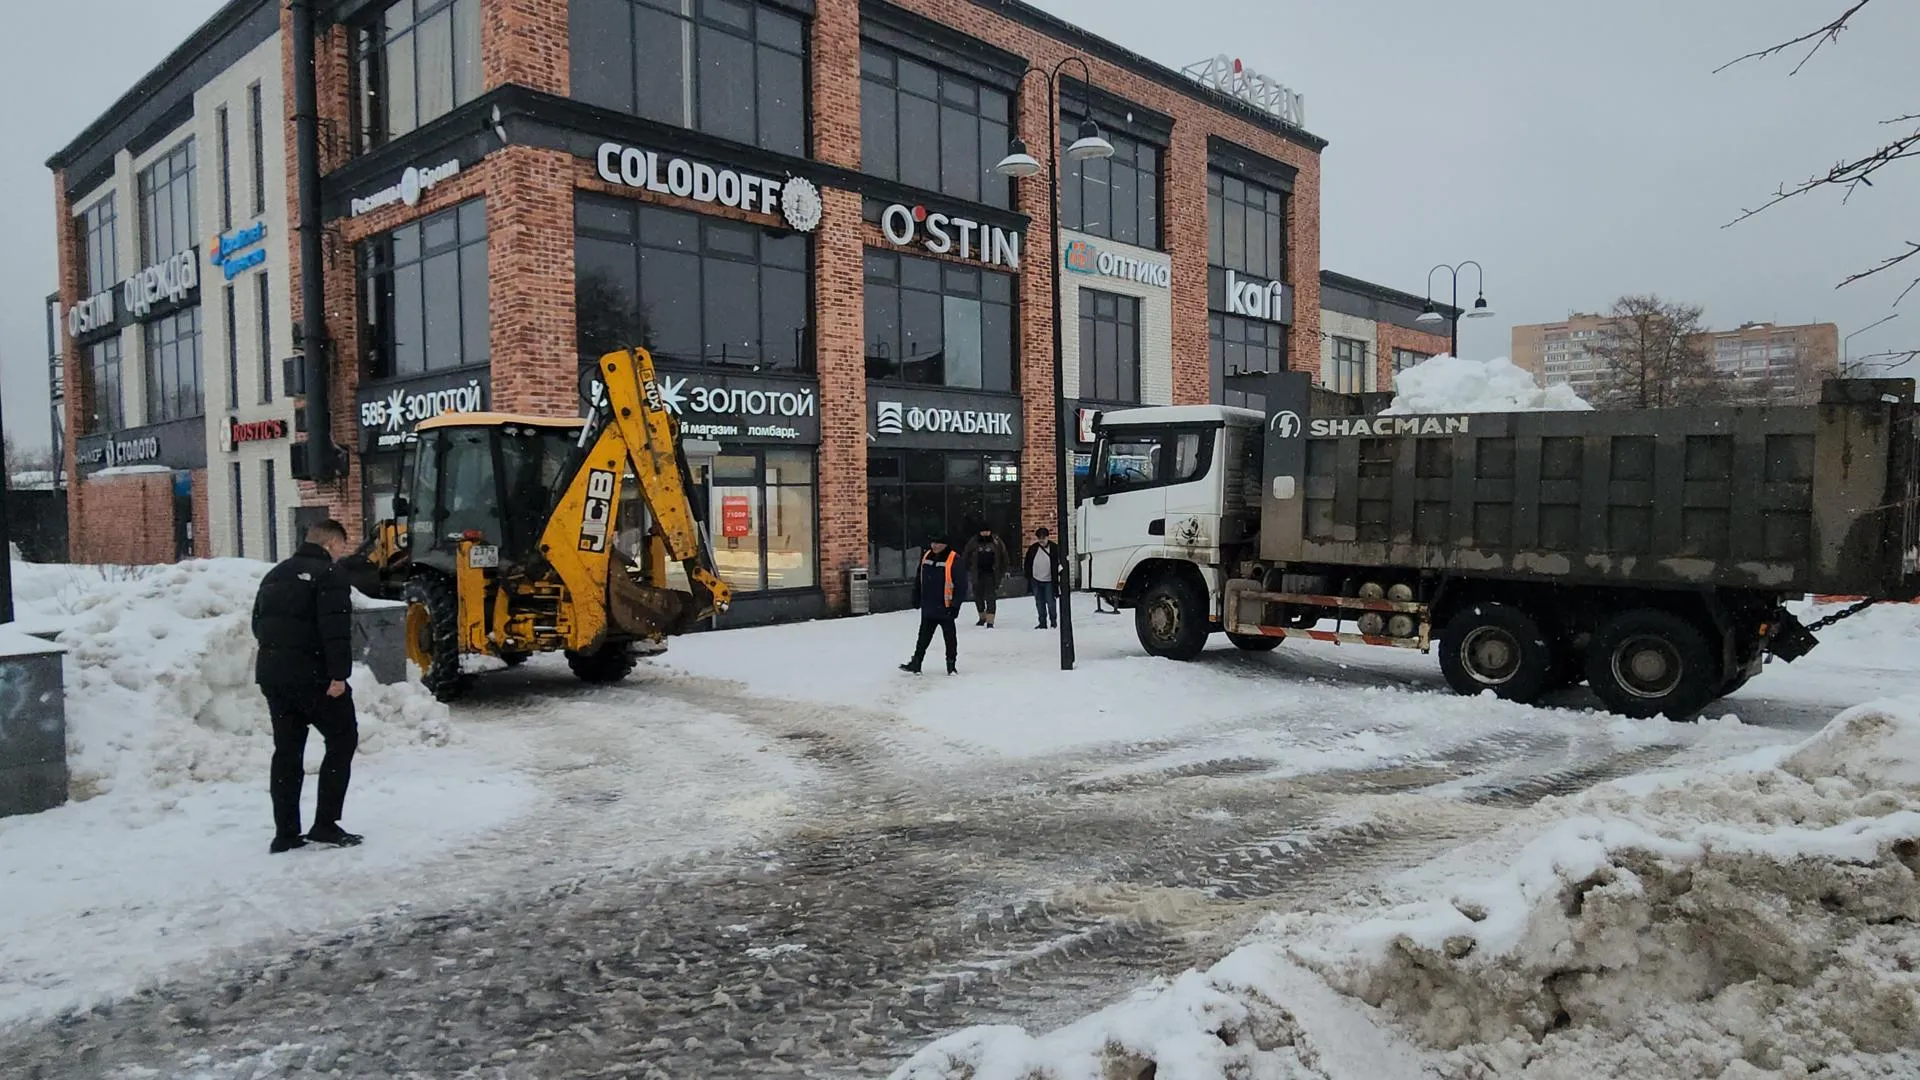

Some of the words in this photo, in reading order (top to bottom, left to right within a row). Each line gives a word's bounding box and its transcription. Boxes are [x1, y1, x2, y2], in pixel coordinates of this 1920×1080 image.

[597, 142, 781, 215] COLODOFF
[881, 204, 1018, 271] O'STIN
[124, 250, 198, 317] одежда
[1226, 269, 1282, 321] kari
[361, 401, 386, 426] 585
[405, 380, 480, 421] ЗОЛОТОЙ
[690, 387, 814, 417] ЗОЛОТОЙ
[907, 407, 1012, 435] ФОРАБАНК
[1310, 416, 1469, 437] SHACMAN
[690, 424, 738, 435] магазин
[584, 471, 614, 551] JCB
